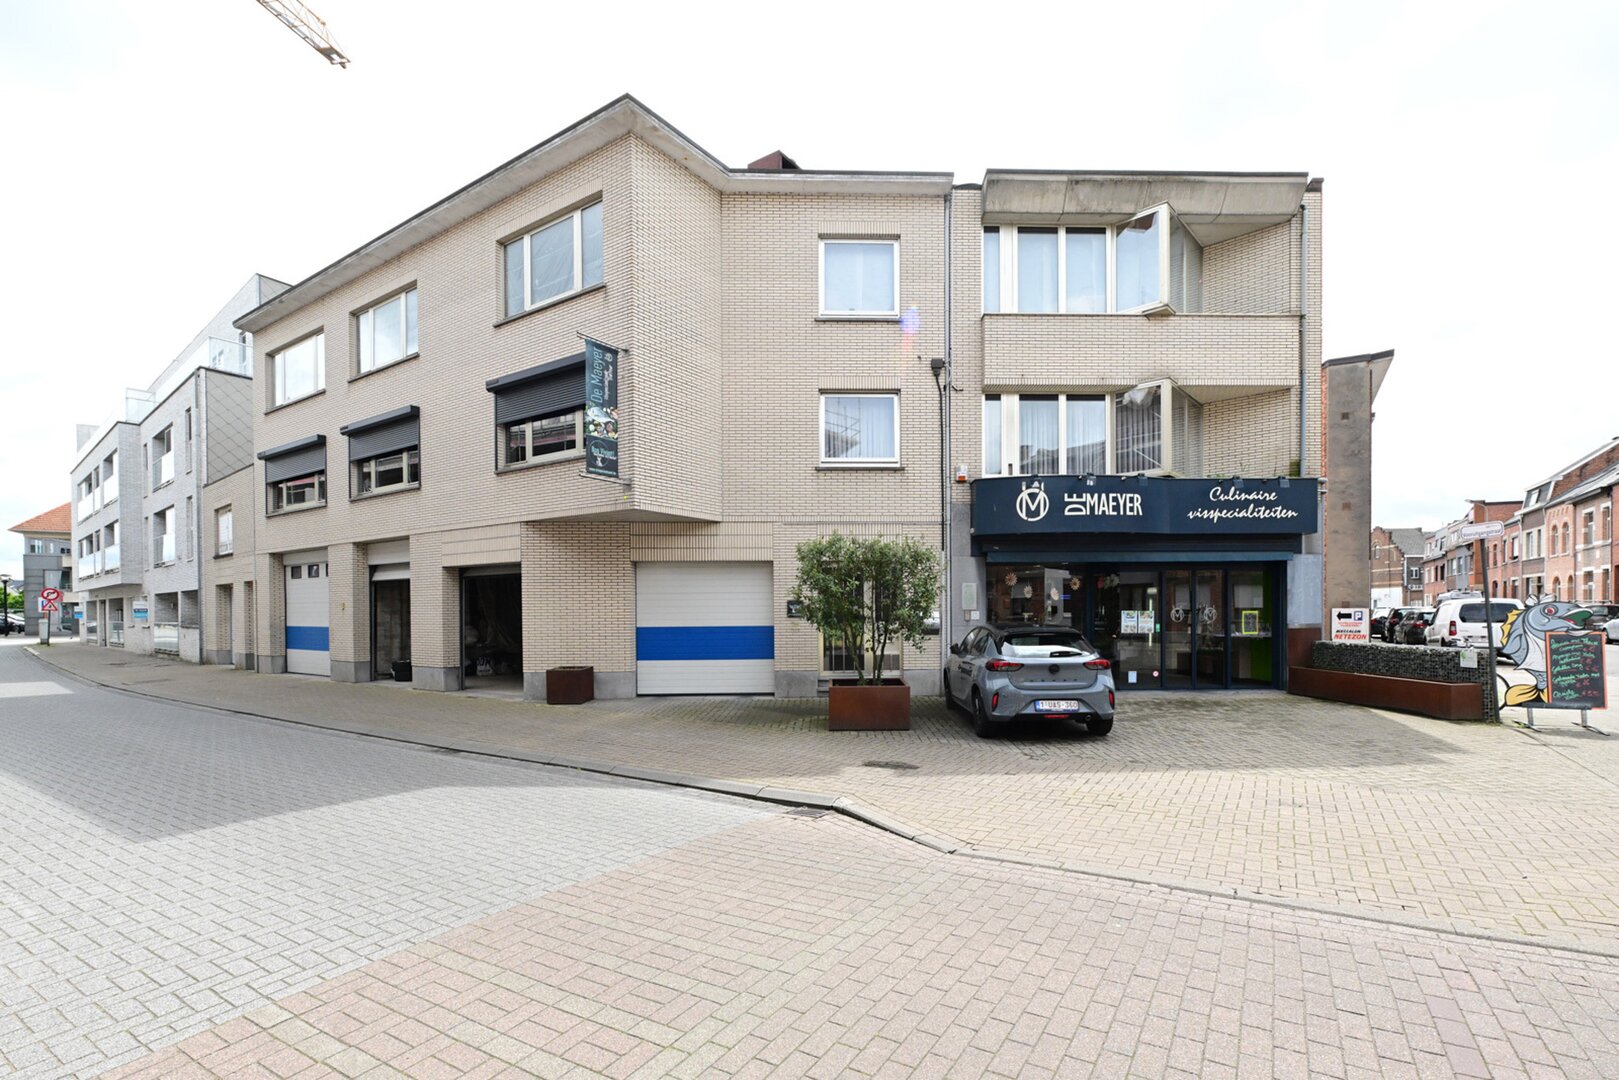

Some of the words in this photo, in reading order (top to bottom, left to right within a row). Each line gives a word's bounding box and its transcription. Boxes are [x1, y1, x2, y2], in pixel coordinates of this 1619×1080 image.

[591, 347, 605, 386] Maeyer
[591, 388, 603, 403] De
[1209, 486, 1278, 501] Culinaire
[1064, 493, 1086, 515] DE
[1086, 493, 1143, 515] MAEYER
[1187, 503, 1298, 523] visspecialiteiten
